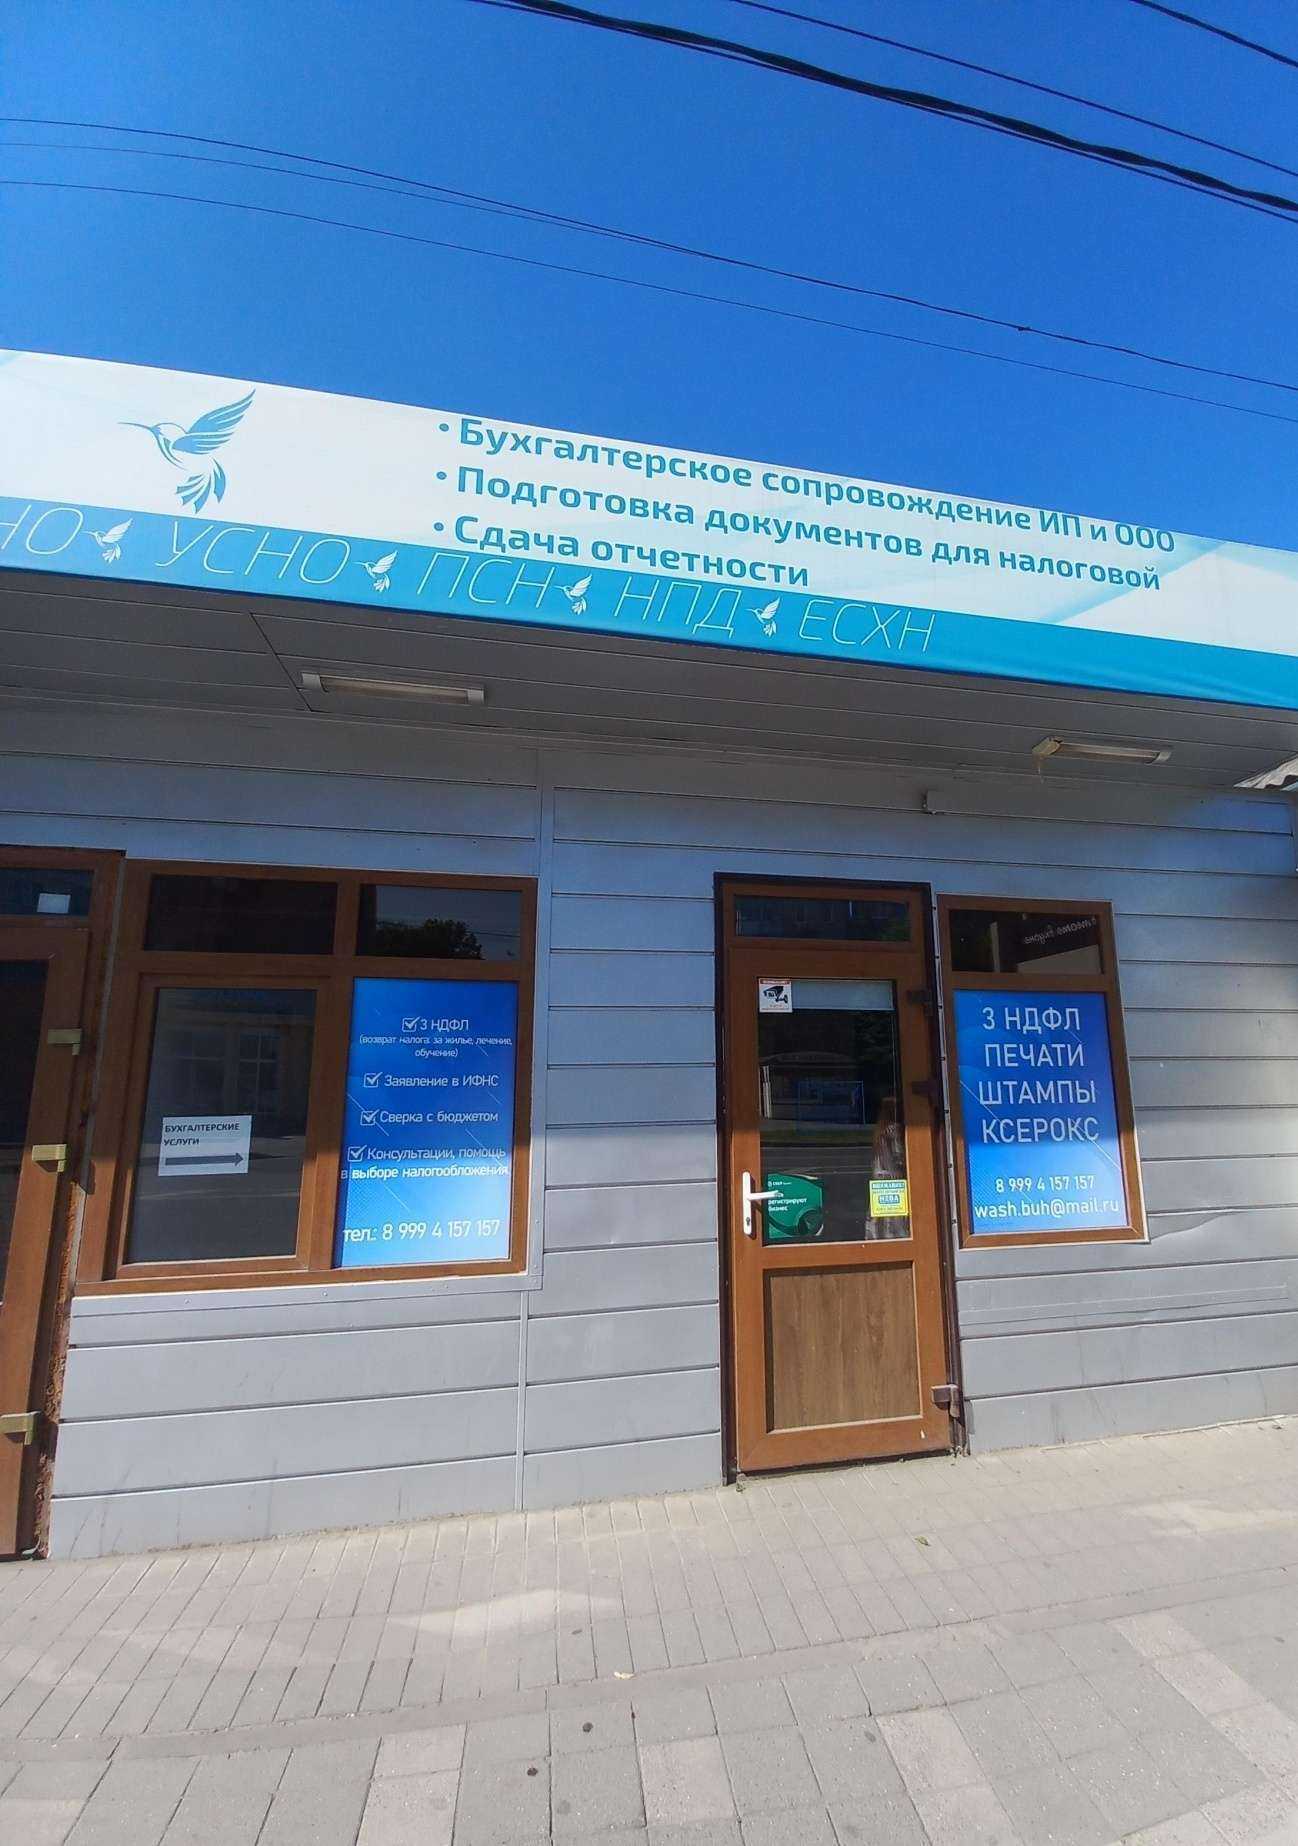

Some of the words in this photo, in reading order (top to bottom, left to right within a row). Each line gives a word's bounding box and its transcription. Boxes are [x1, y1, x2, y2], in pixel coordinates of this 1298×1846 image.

[460, 418, 752, 486] Бухгалтерское
[761, 471, 1031, 530] сопровождение
[1039, 509, 1081, 538] ИП
[1090, 525, 1108, 541] и
[1114, 524, 1176, 553] ООО
[457, 466, 695, 525] Подготовка
[704, 509, 923, 557] документов
[931, 540, 990, 567] для
[998, 551, 1160, 591] налоговой
[454, 515, 579, 558] Сдача
[591, 540, 809, 587] отчетности
[154, 521, 352, 585] УСНО
[416, 552, 556, 609] ПСН
[613, 576, 742, 639] НПД
[799, 599, 936, 654] ЕСХН
[431, 1018, 469, 1032] НДФЛ
[1004, 1007, 1081, 1035] НДФЛ
[433, 1036, 444, 1044] за
[414, 1047, 459, 1059] обучение)
[984, 1043, 1085, 1068] ПЕЧАТИ
[384, 1074, 449, 1087] Заявление
[452, 1078, 459, 1086] в
[462, 1074, 499, 1087] ИФНС
[979, 1080, 1097, 1105] ШТАМПЫ
[379, 1110, 423, 1125] Сверка
[426, 1113, 434, 1122] с
[437, 1110, 499, 1124] бюджетом
[164, 1122, 241, 1133] БУХГАЛТЕРСКИЕ
[982, 1116, 1100, 1144] КСЕРОКС
[163, 1137, 200, 1146] УСЛУГИ
[367, 1148, 455, 1162] Консультации,
[458, 1147, 507, 1161] помощь
[340, 1170, 349, 1180] в
[351, 1166, 399, 1181] выборе
[995, 1178, 1005, 1193] 8
[1008, 1177, 1032, 1192] 999
[1036, 1177, 1046, 1191] 4
[1050, 1176, 1070, 1191] 157
[1075, 1175, 1096, 1190] 157
[974, 1198, 1121, 1219] wash.buh@mail.ru
[382, 1223, 393, 1241] 8
[398, 1222, 427, 1240] 999
[432, 1222, 443, 1239] 4
[447, 1220, 472, 1238] 157
[476, 1219, 501, 1237] 157
